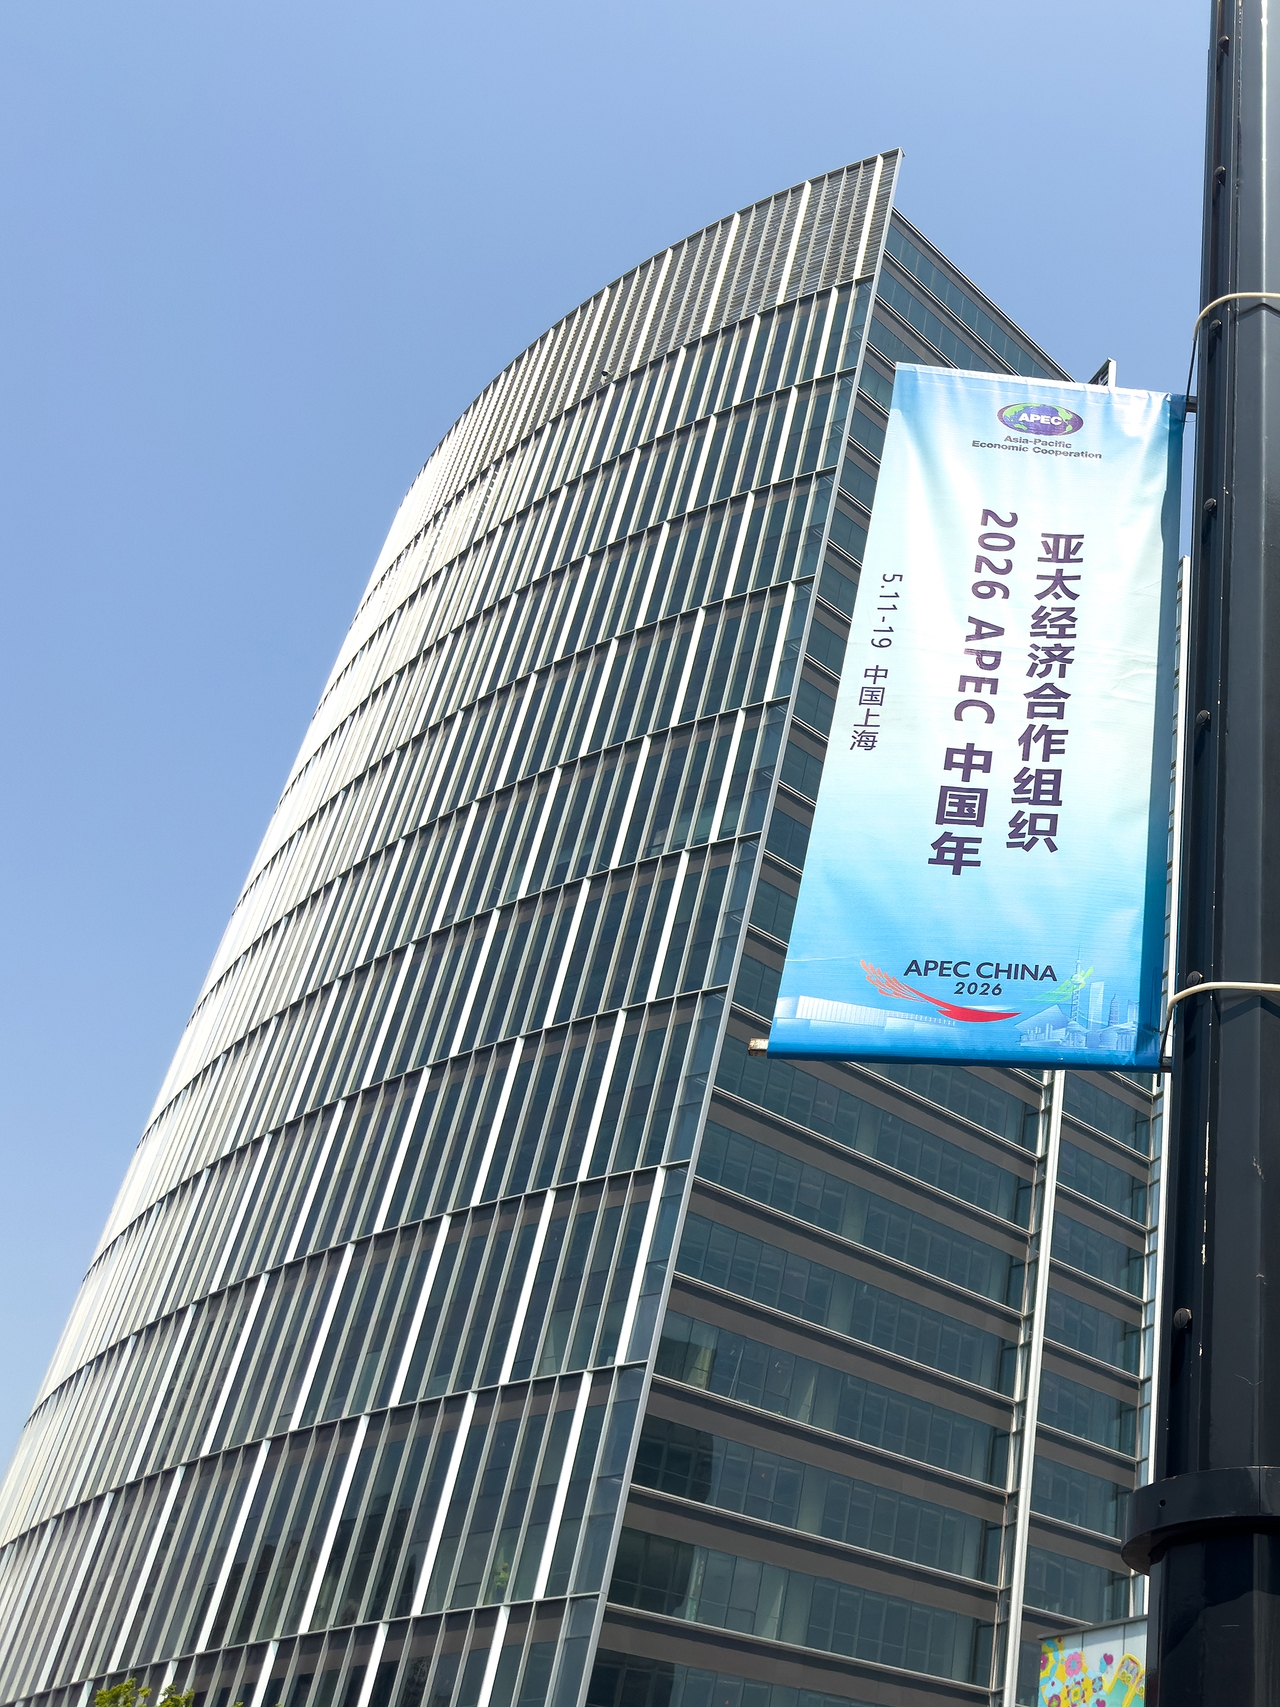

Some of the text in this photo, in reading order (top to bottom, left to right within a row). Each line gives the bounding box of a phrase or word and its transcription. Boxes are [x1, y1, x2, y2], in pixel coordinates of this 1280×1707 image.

[1018, 412, 1062, 426] APEC
[971, 440, 1102, 459] Economic Cooperation
[1004, 435, 1072, 449] Asia-Pacific
[850, 574, 903, 751] 5.11-19 中国上海
[928, 509, 1018, 875] 2026 APEC 中国年
[1006, 533, 1084, 853] 亚太经济合作组织
[903, 959, 1058, 982] APEC CHINA
[954, 982, 1002, 996] 2026
